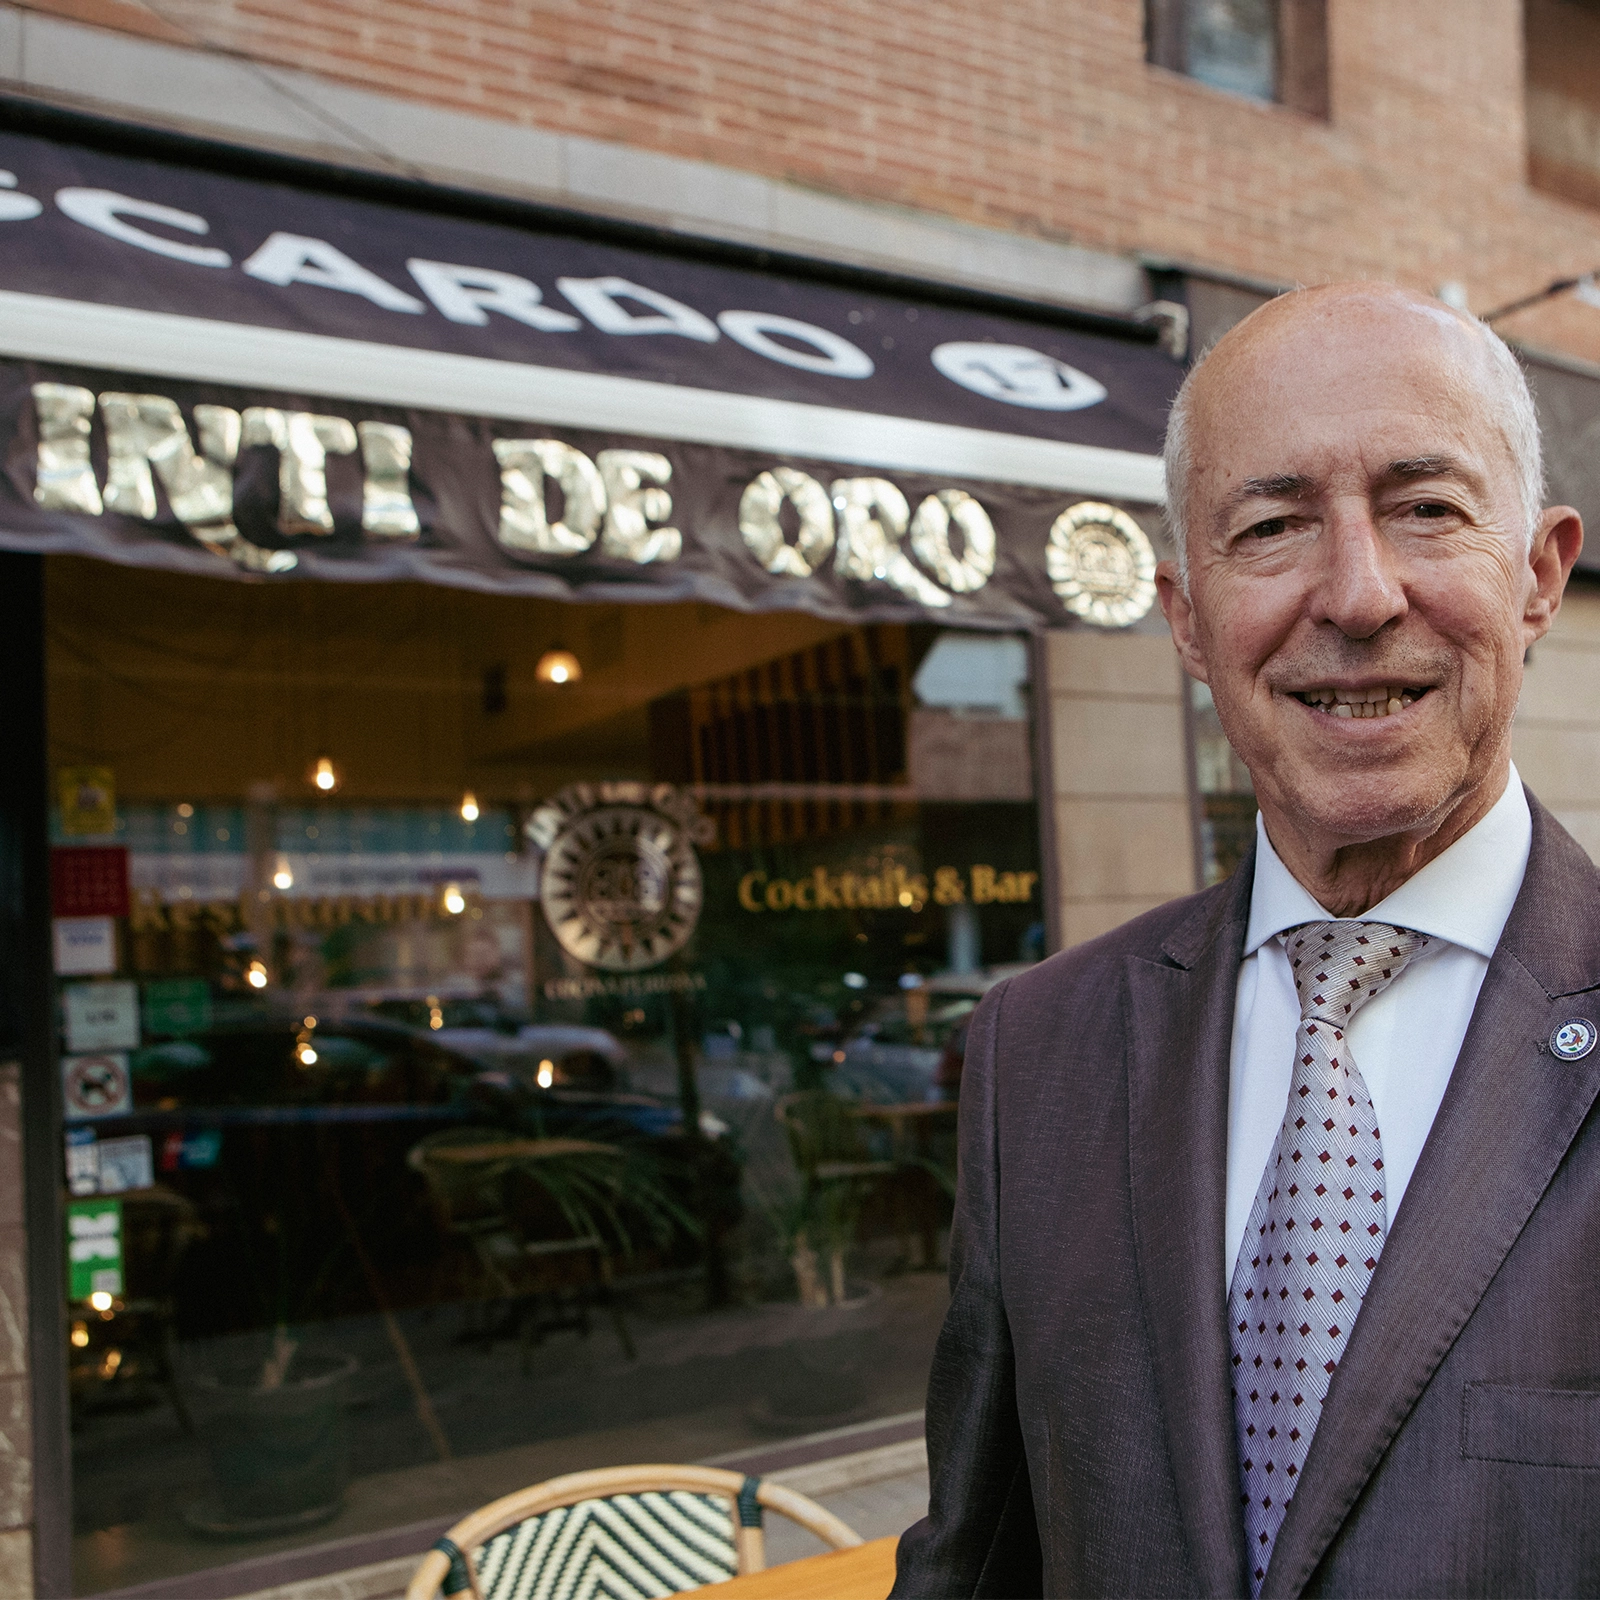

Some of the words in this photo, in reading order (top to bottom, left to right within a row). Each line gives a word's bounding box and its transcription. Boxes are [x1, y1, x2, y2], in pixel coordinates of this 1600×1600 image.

[31, 381, 421, 573] INTI
[492, 437, 683, 564] DE
[738, 466, 996, 607] ORO
[933, 865, 966, 907] &
[970, 862, 1038, 905] Bar
